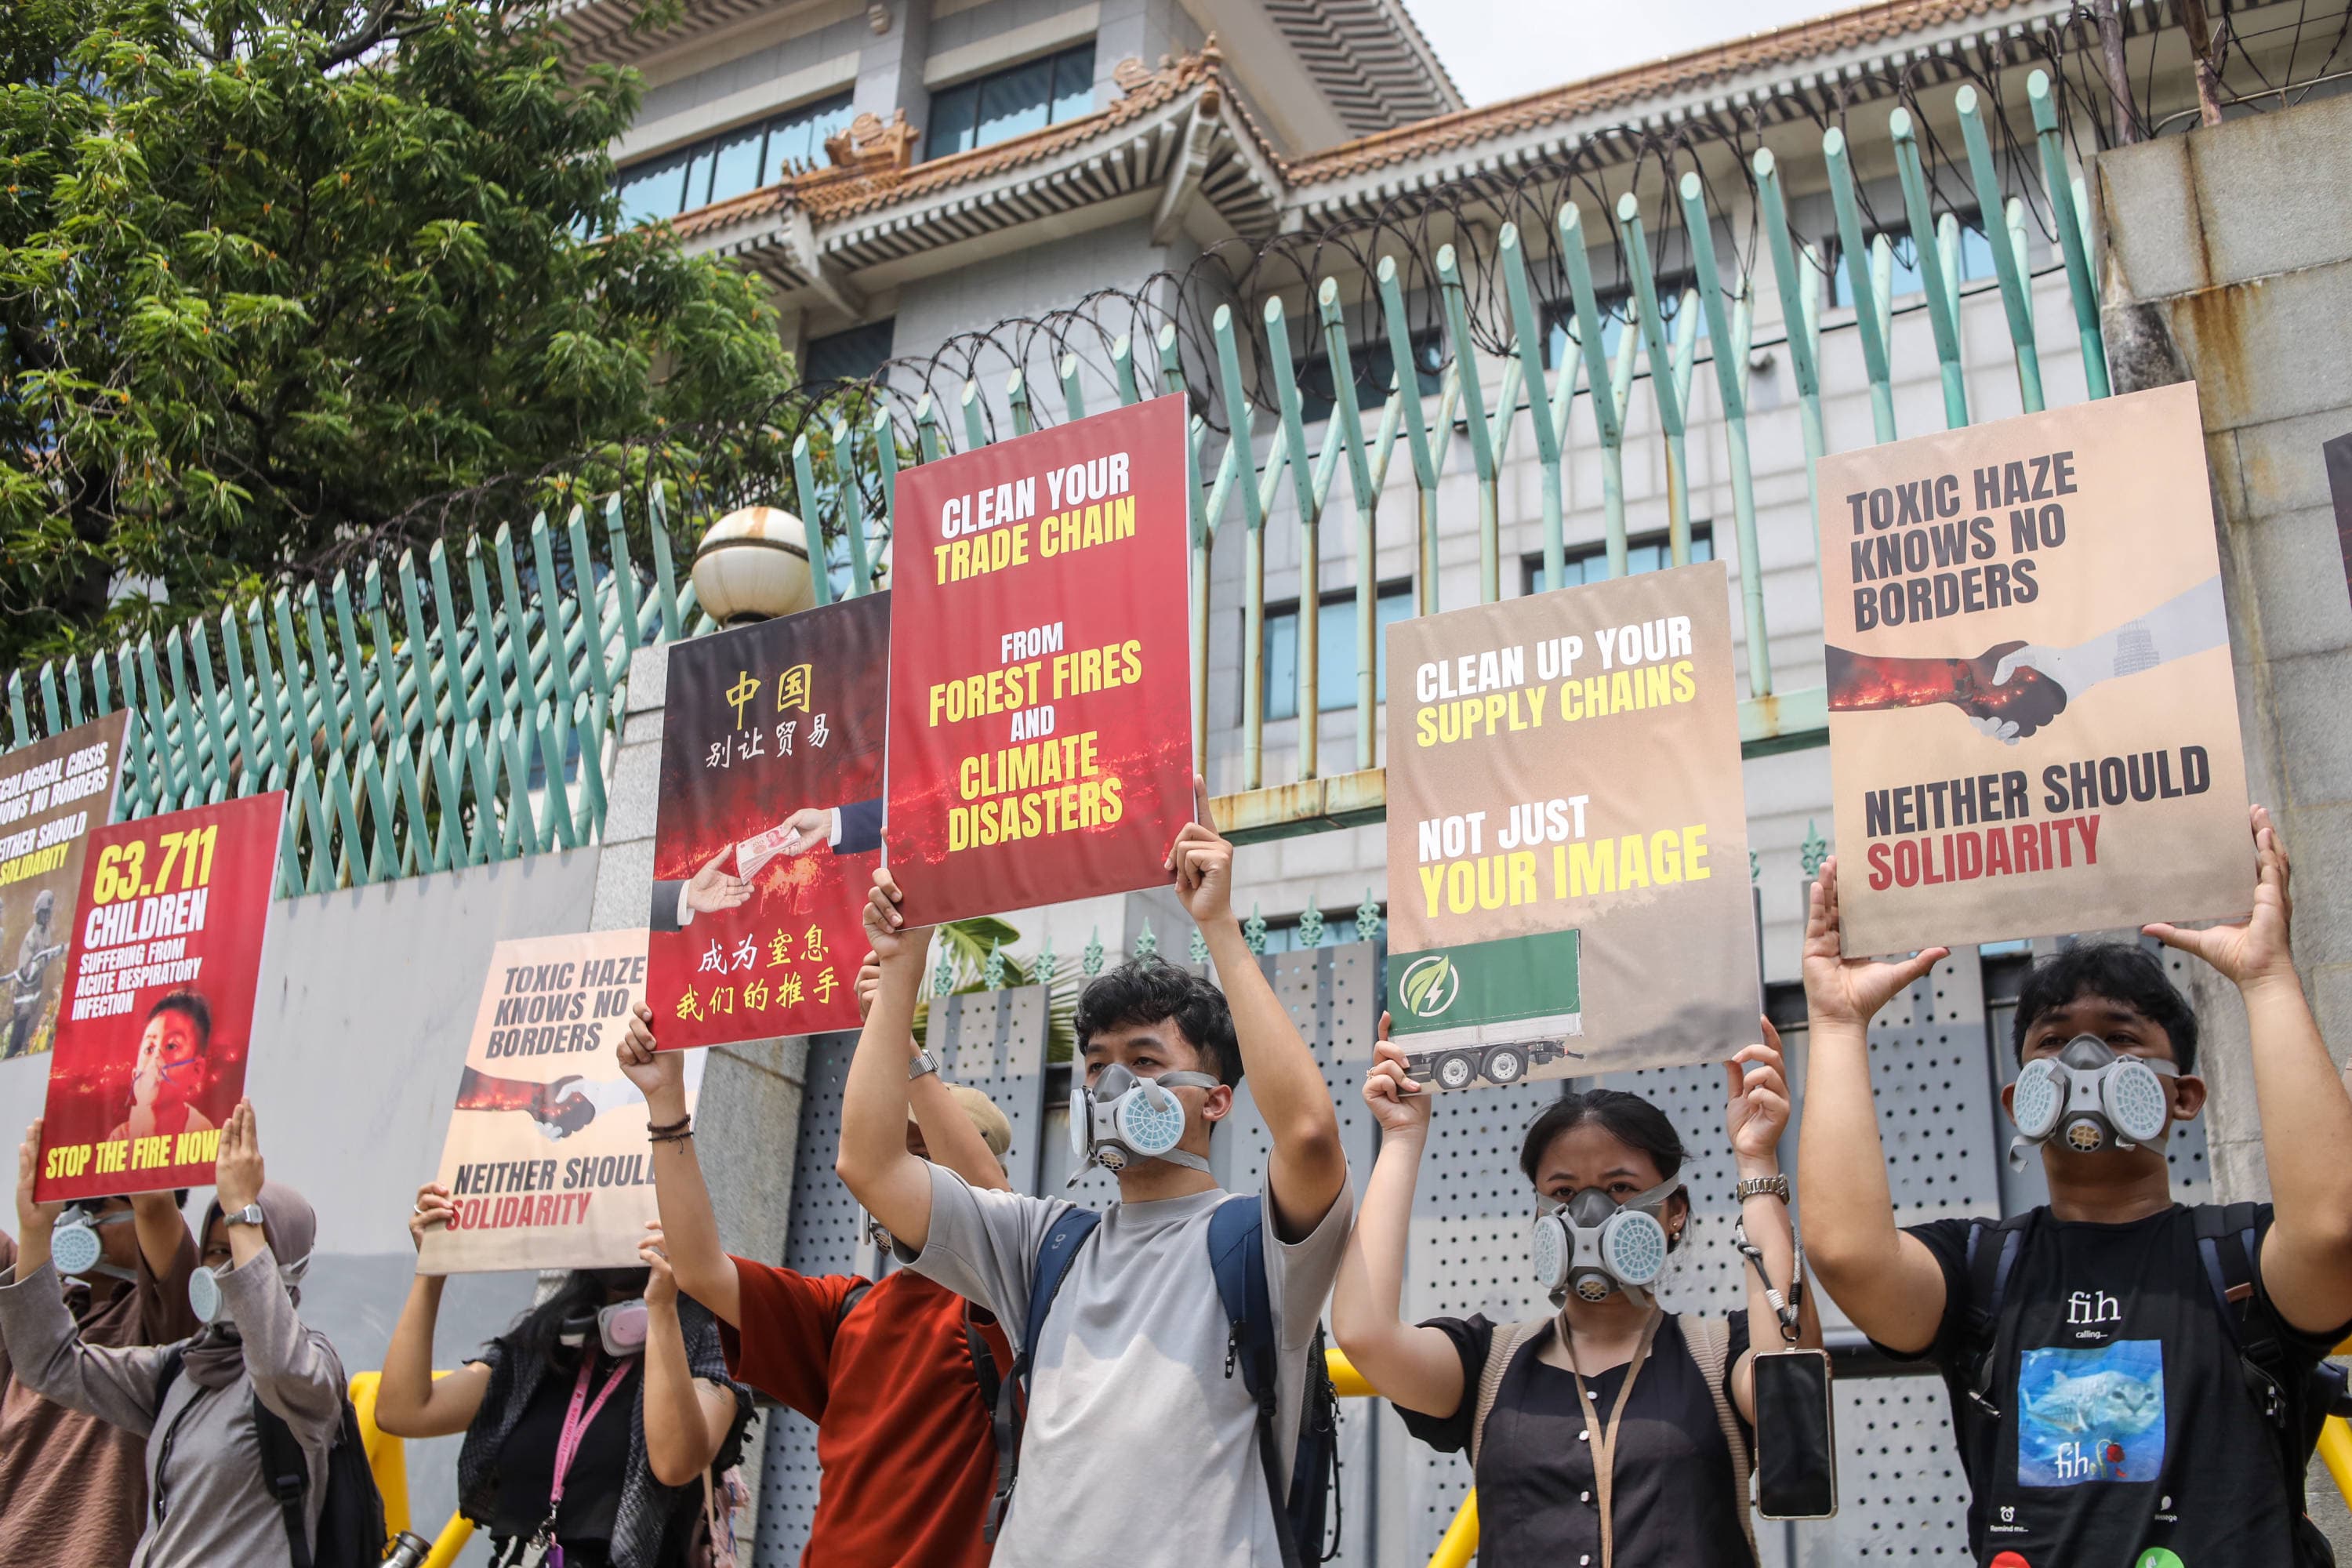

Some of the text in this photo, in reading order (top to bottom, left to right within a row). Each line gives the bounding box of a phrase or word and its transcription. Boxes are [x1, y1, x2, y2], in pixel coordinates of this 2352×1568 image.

[942, 452, 1130, 539] CLEAN YOUR
[1846, 451, 2078, 535] TOXIC HAZE
[935, 495, 1136, 586] TRADE CHAIN
[1851, 503, 2066, 583] KNOWS NO
[1853, 559, 2038, 633] BORDERS
[1001, 622, 1064, 663] FROM
[1416, 615, 1692, 702] CLEAN UP YOUR
[726, 664, 812, 731] 中国
[929, 639, 1142, 727] FOREST FIRES
[1417, 660, 1695, 747] SUPPLY CHAINS
[706, 713, 829, 768] 别让贸易
[1011, 706, 1054, 742] AND
[0, 742, 108, 801] COLOGICAL CRISIS
[31, 786, 50, 815] NO
[50, 766, 109, 808] BORDERS
[960, 731, 1098, 800] CLIMATE
[1865, 745, 2210, 837] NEITHER SHOULD
[37, 811, 88, 849] SHOULD
[948, 777, 1123, 852] DISASTERS
[1418, 794, 1588, 862] NOT JUST
[0, 842, 70, 886] SOLIDARITY
[93, 825, 218, 905] 63.711
[1418, 823, 1710, 918] YOUR IMAGE
[1867, 814, 2101, 891] SOLIDARITY
[84, 887, 209, 950] CHILDREN
[75, 957, 202, 998] ACUTE RESPIRATORY
[79, 937, 186, 975] SUFFERING FROM
[504, 956, 646, 995] TOXIC HAZE
[698, 924, 829, 975] 成为窒息
[71, 990, 135, 1021] INFECTION
[493, 988, 630, 1027] KNOWS NO
[676, 966, 840, 1022] 我们的推手
[485, 1022, 603, 1058] BORDERS
[45, 1144, 92, 1179] STOP
[95, 1140, 129, 1174] THE
[131, 1134, 172, 1170] FIRE
[453, 1159, 557, 1195] NEITHER
[446, 1192, 592, 1231] SOLIDARITY
[2067, 1290, 2122, 1323] fih
